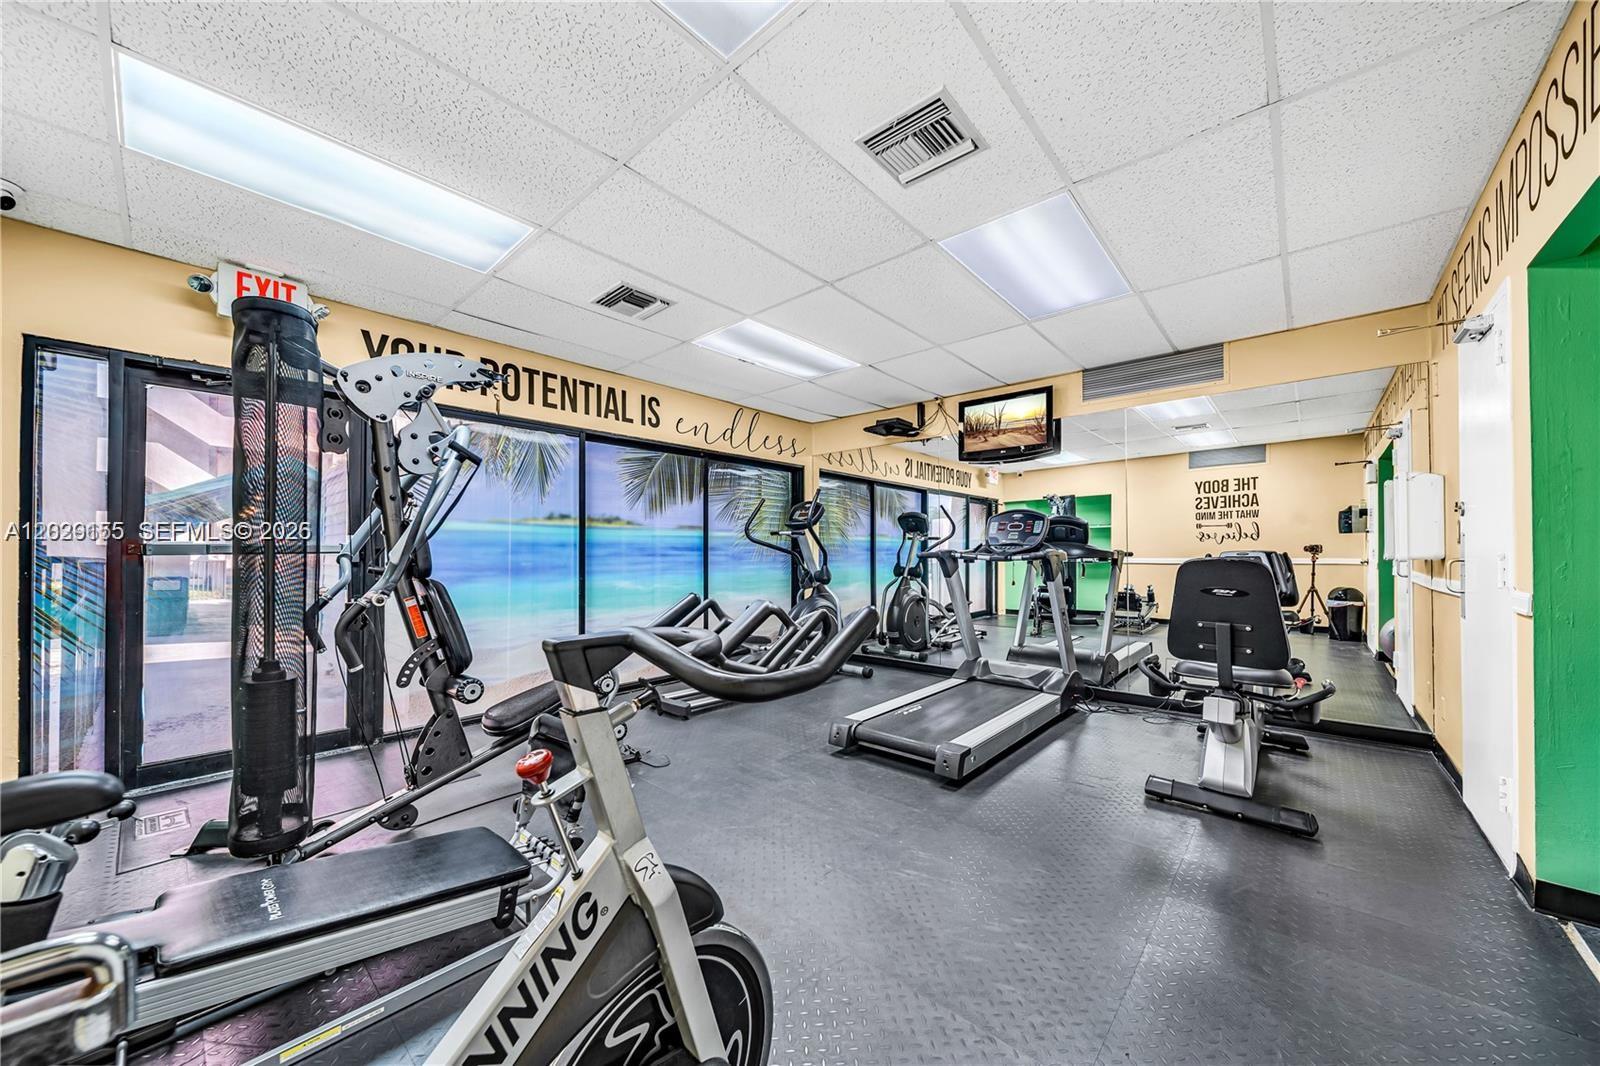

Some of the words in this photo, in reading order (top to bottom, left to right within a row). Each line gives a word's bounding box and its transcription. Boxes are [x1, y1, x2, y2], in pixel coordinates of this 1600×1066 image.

[1451, 206, 1492, 333] SEEMS
[405, 369, 443, 384] INSPIRE
[641, 394, 661, 429] IS
[675, 407, 807, 459] endless
